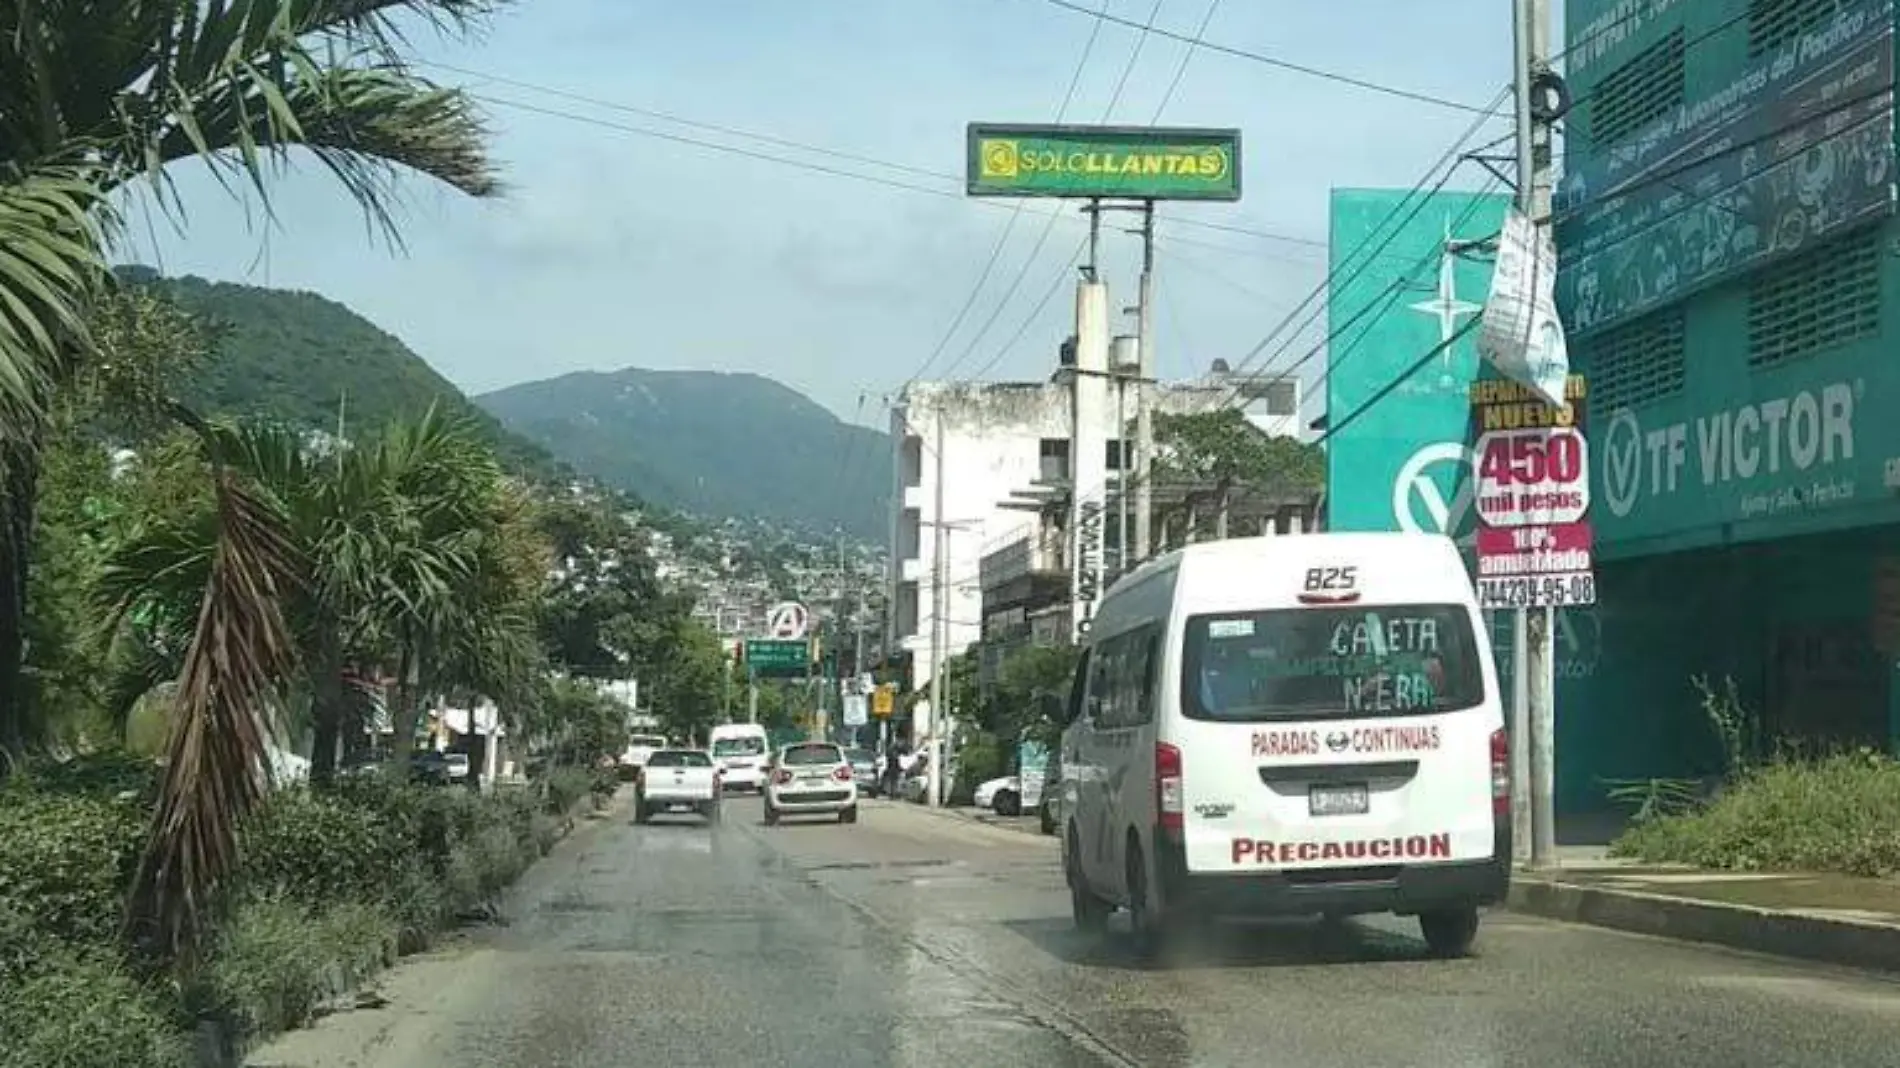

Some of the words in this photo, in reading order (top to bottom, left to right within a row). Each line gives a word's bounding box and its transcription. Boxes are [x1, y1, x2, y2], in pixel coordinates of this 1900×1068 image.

[1483, 400, 1574, 429] NUEVO
[1647, 422, 1688, 497] TF
[1697, 383, 1854, 486] VICTOR
[1479, 432, 1582, 486] 450
[1481, 492, 1514, 513] mil
[1519, 491, 1582, 512] pesos
[1304, 566, 1358, 591] 825
[1251, 730, 1320, 756] PARADAS
[1353, 726, 1441, 752] CONTINUAS
[1232, 832, 1451, 864] PRECAUCION
